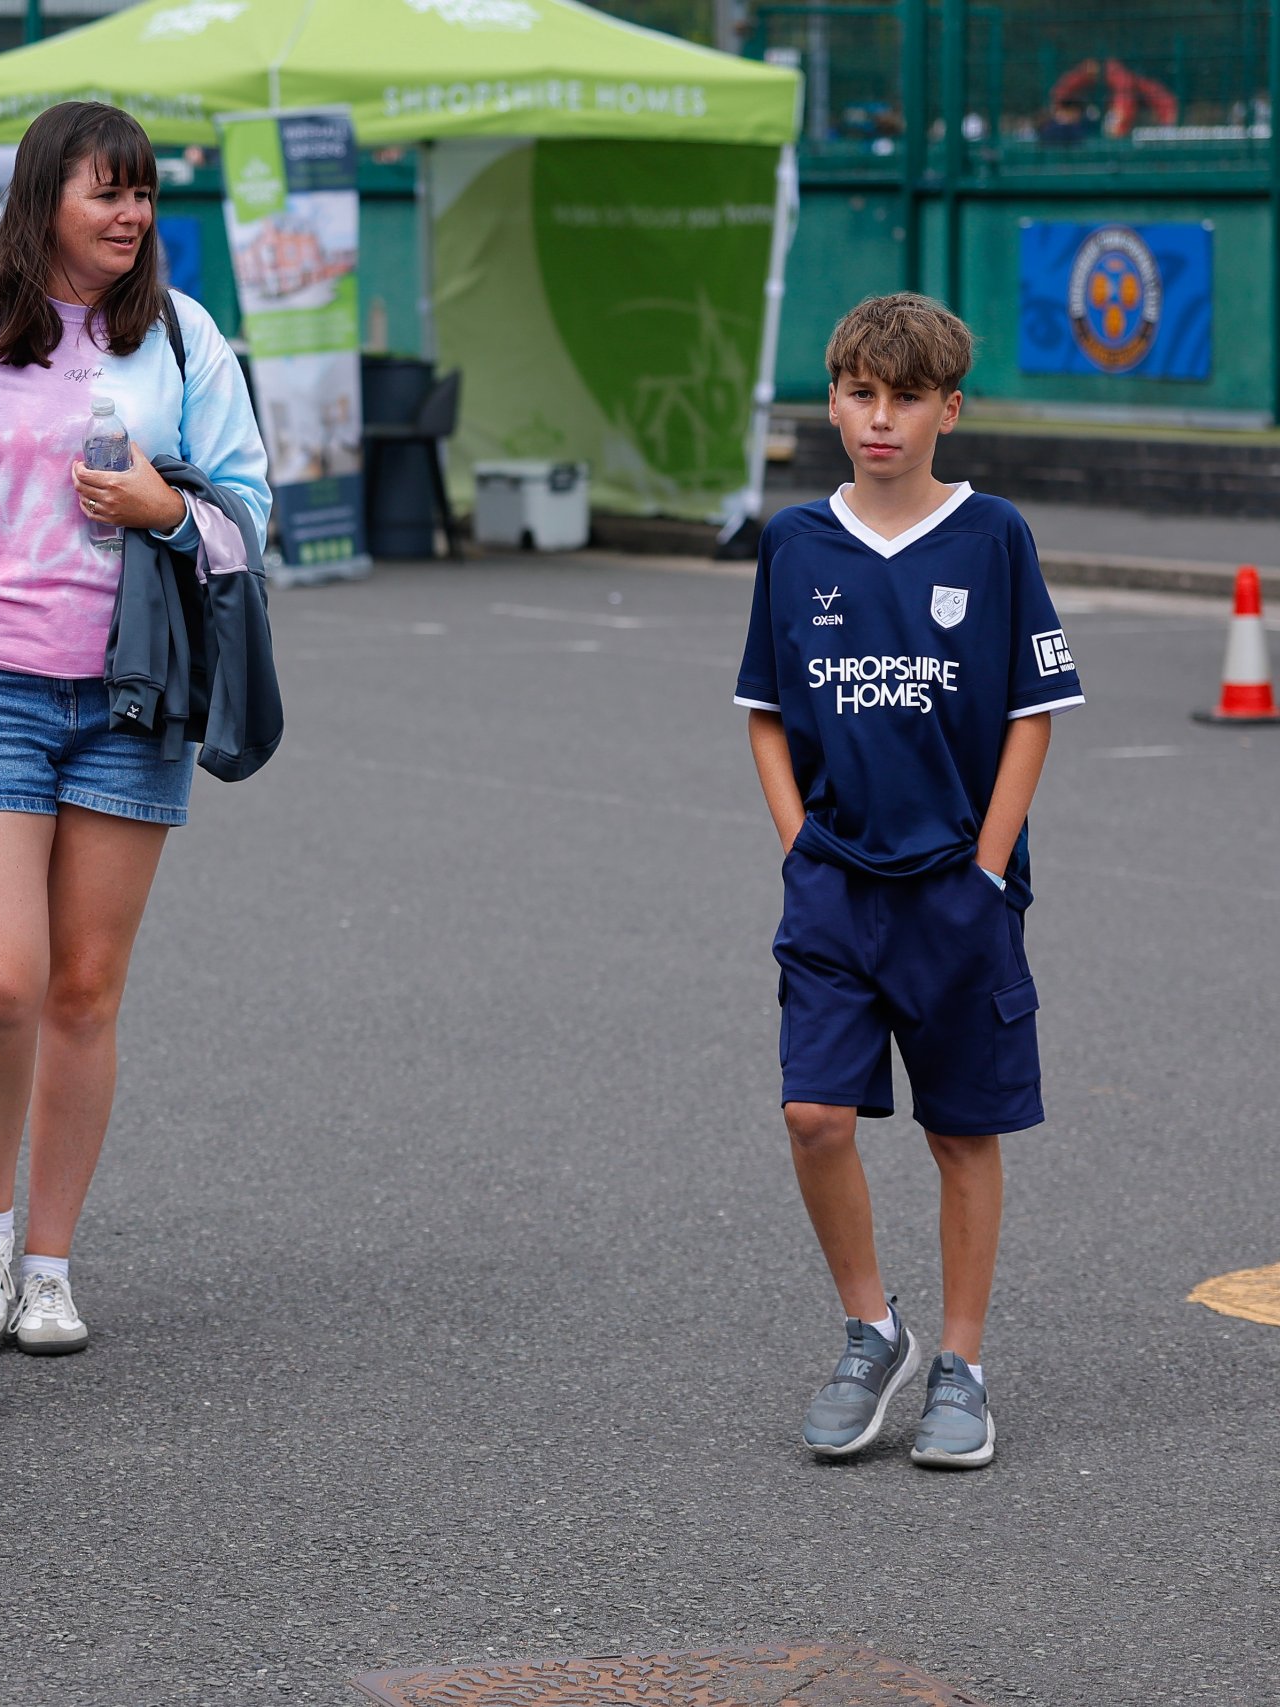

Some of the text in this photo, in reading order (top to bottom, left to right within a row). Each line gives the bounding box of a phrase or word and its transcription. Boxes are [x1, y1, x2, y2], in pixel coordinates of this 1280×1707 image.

[383, 80, 707, 117] SHROPSHIRE HOMES
[812, 614, 844, 626] OXEN
[808, 655, 960, 692] SHROPSHIRE
[836, 682, 933, 714] HOMES
[835, 1356, 874, 1381] NIKE
[931, 1385, 971, 1406] NIKE
